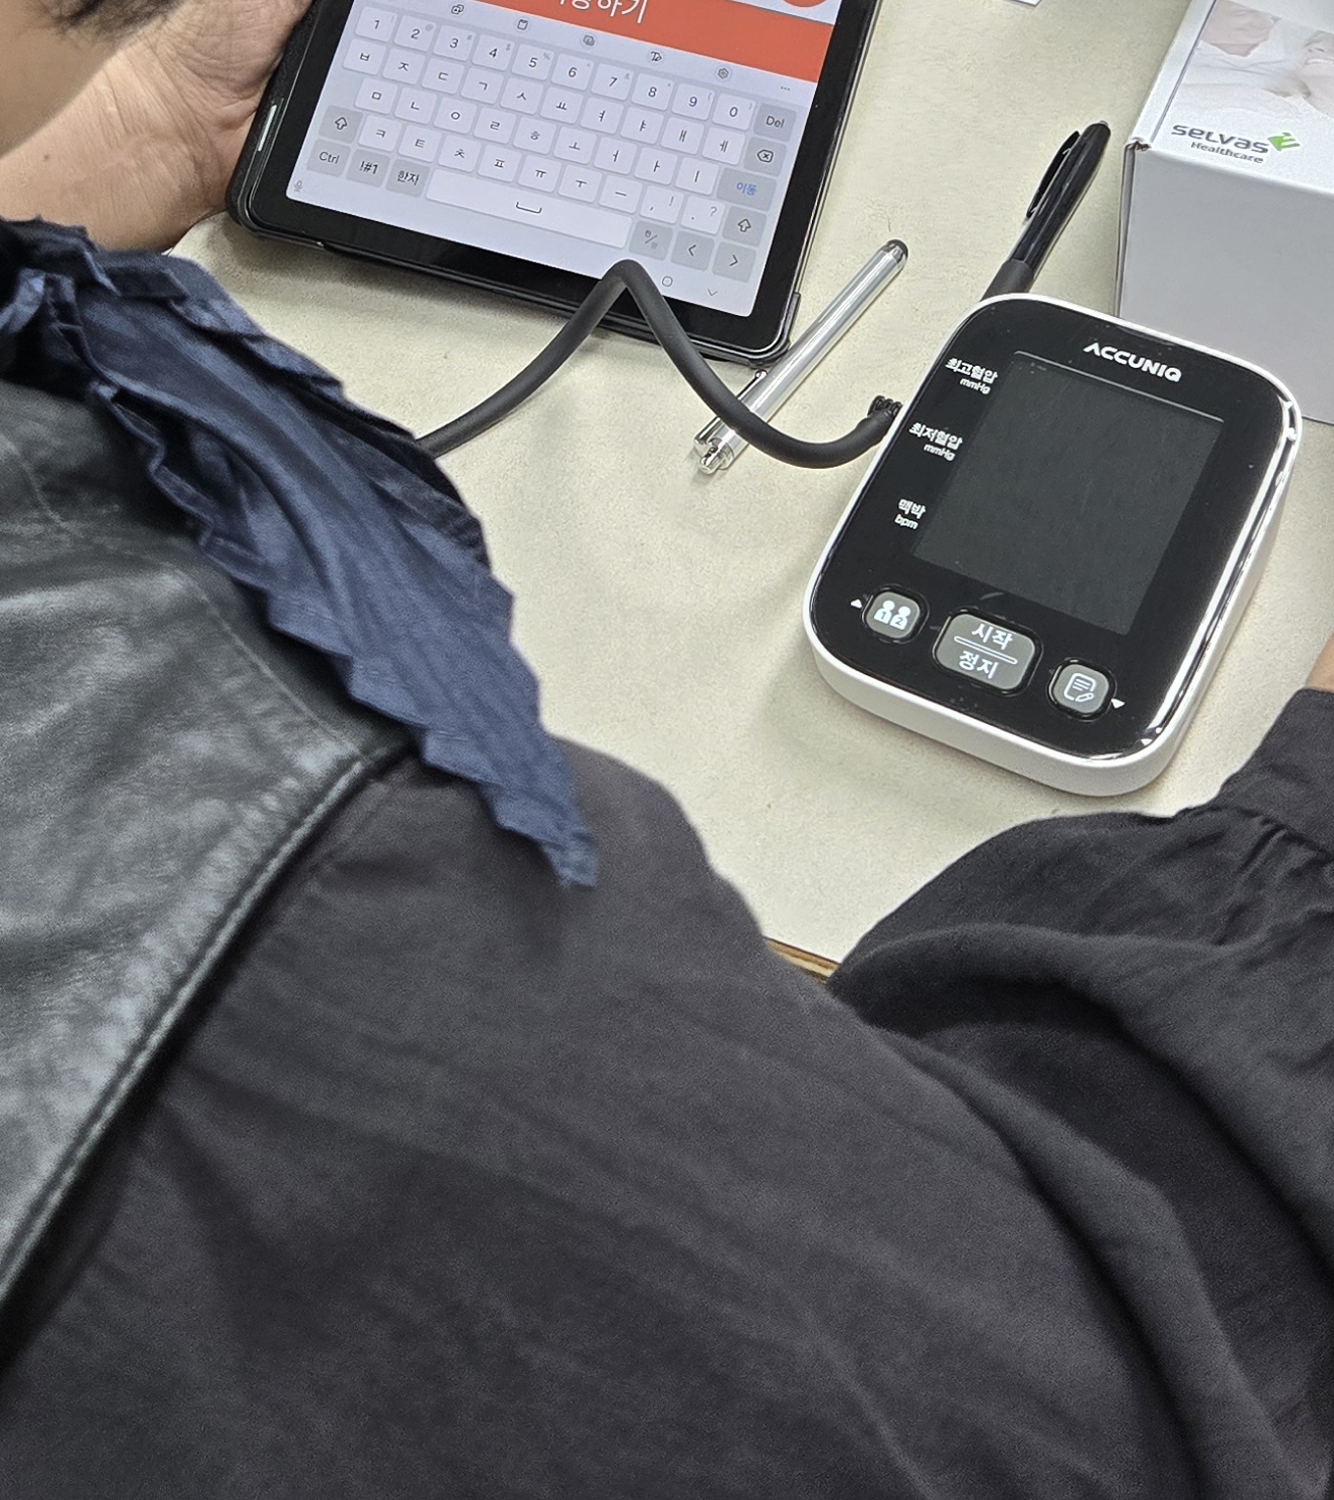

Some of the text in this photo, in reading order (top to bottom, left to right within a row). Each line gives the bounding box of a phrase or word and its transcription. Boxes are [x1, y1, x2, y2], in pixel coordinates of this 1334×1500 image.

[374, 20, 784, 127] 1 2 3 4 5 6 7 8 9 0 Del
[1190, 140, 1264, 164] Healthcare
[319, 152, 339, 164] Ctrl
[360, 161, 378, 174] !#1
[398, 171, 419, 185] 한자
[737, 182, 756, 195] 이동
[945, 357, 999, 385] 최고혈압
[1083, 342, 1182, 383] ACCUNIQ
[960, 376, 991, 395] mmHg
[908, 422, 963, 451] 최저혈압
[924, 442, 956, 462] mmHg
[894, 514, 919, 530] bpm
[897, 498, 927, 520] 맥박
[971, 622, 1013, 651] 시작
[958, 650, 999, 679] 정지
